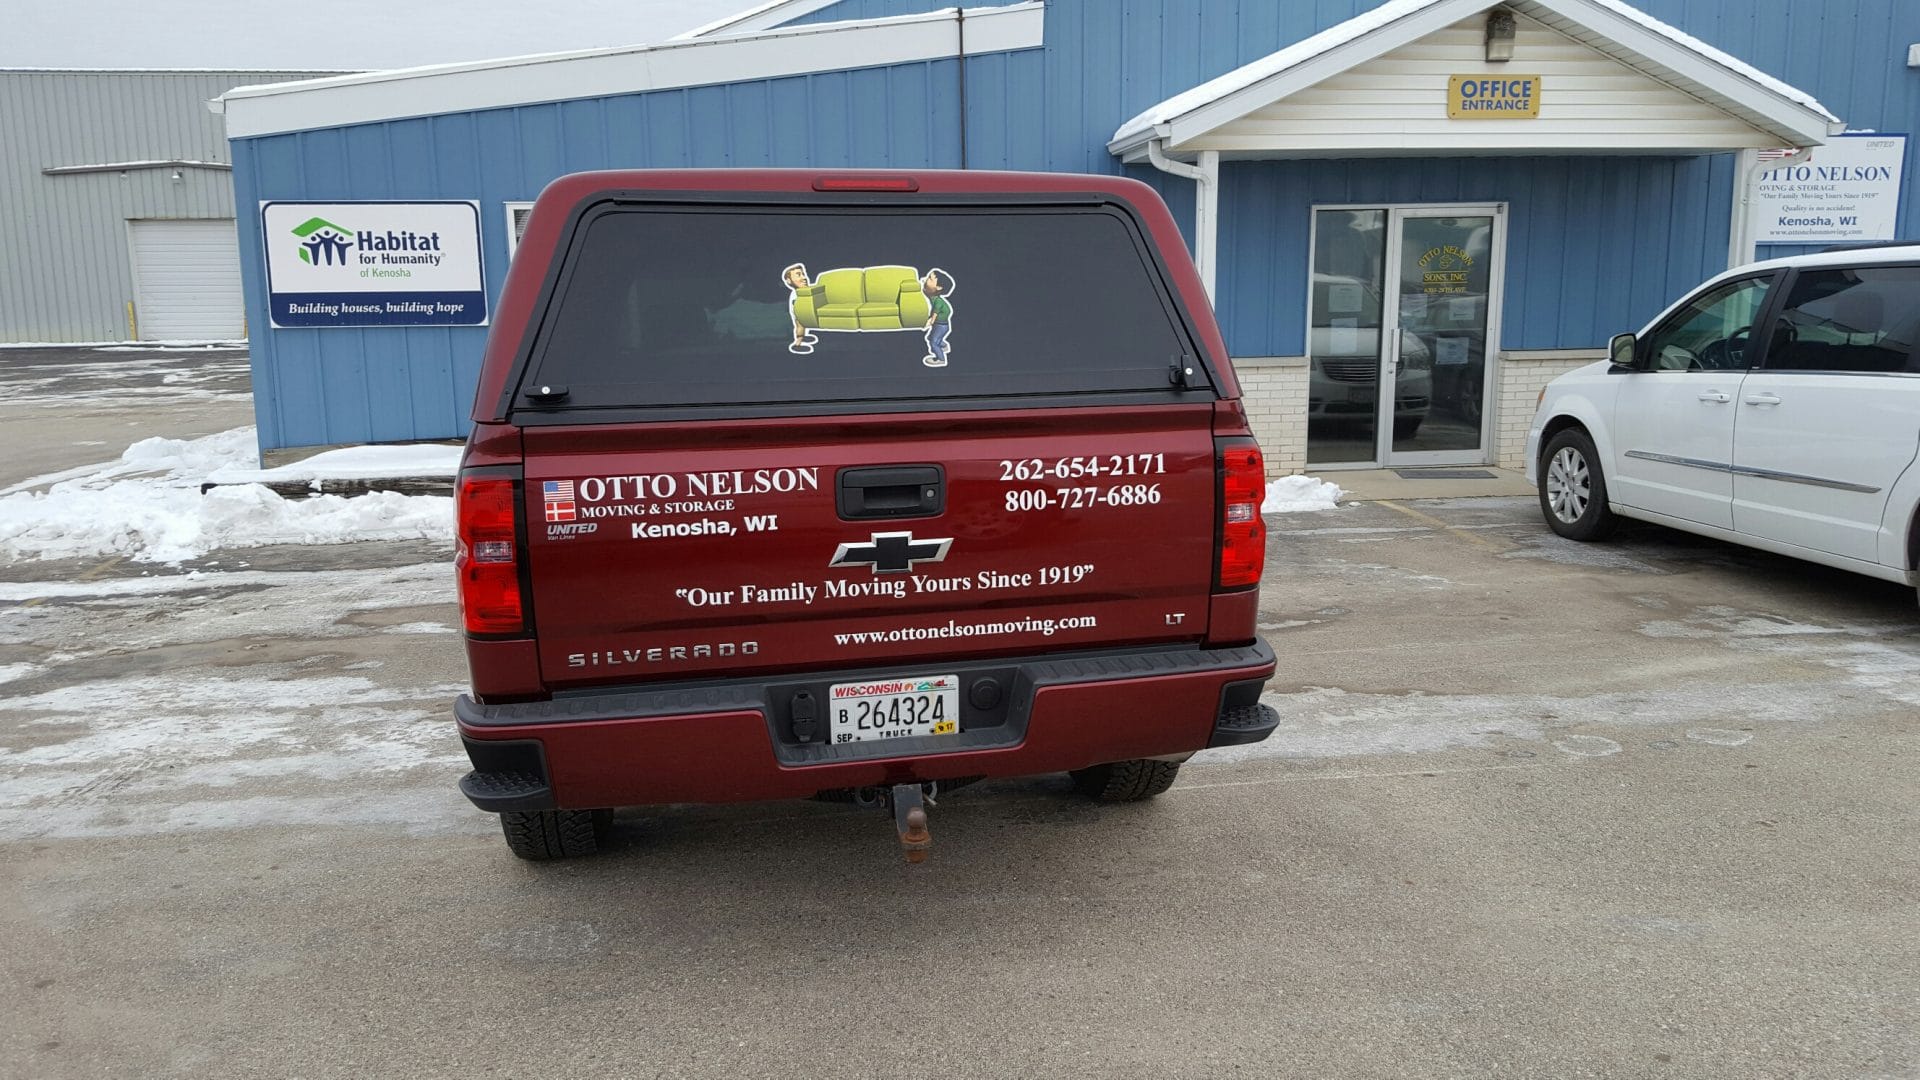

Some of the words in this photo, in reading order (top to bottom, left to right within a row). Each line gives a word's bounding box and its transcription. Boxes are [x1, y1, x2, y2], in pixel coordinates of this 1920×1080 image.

[1461, 80, 1532, 98] OFFICE
[1462, 100, 1529, 110] ENTRANCE
[1866, 140, 1895, 148] UNITED
[1760, 166, 1811, 181] TTO
[1816, 166, 1892, 181] NELSON
[1778, 192, 1799, 200] Family
[1801, 192, 1823, 200] Moving
[1782, 204, 1807, 213] Quality
[1778, 216, 1834, 227] Kenosha,
[1839, 216, 1858, 226] WI
[357, 230, 440, 251] Habitat
[359, 254, 377, 264] for
[1418, 248, 1440, 267] OTTO
[360, 268, 369, 278] of
[372, 268, 411, 278] Kenosha
[289, 302, 338, 316] Building
[341, 302, 384, 314] houses,
[386, 301, 434, 315] building
[436, 301, 464, 313] hope
[1000, 453, 1167, 481] 262-654-2171
[580, 474, 676, 502] OTTO
[686, 467, 819, 497] NELSON
[1005, 483, 1162, 512] 800-727-6886
[581, 504, 645, 518] MOVING
[649, 503, 661, 515] &
[664, 499, 736, 513] STORAGE
[547, 522, 598, 535] UNITED
[631, 516, 737, 539] Kenosha,
[744, 514, 778, 532] WI
[740, 582, 817, 604] Family
[824, 577, 906, 599] Moving
[911, 573, 972, 593] Yours
[977, 569, 1032, 591] Since
[1165, 613, 1185, 626] LT
[834, 614, 1097, 646] www.ottonelsonmoving.com
[568, 641, 759, 667] SILVERADO
[835, 683, 903, 698] WISCONSIN
[839, 709, 849, 724] B
[857, 694, 944, 731] 264324
[837, 733, 853, 743] SEP
[879, 728, 913, 739] TRUCK
